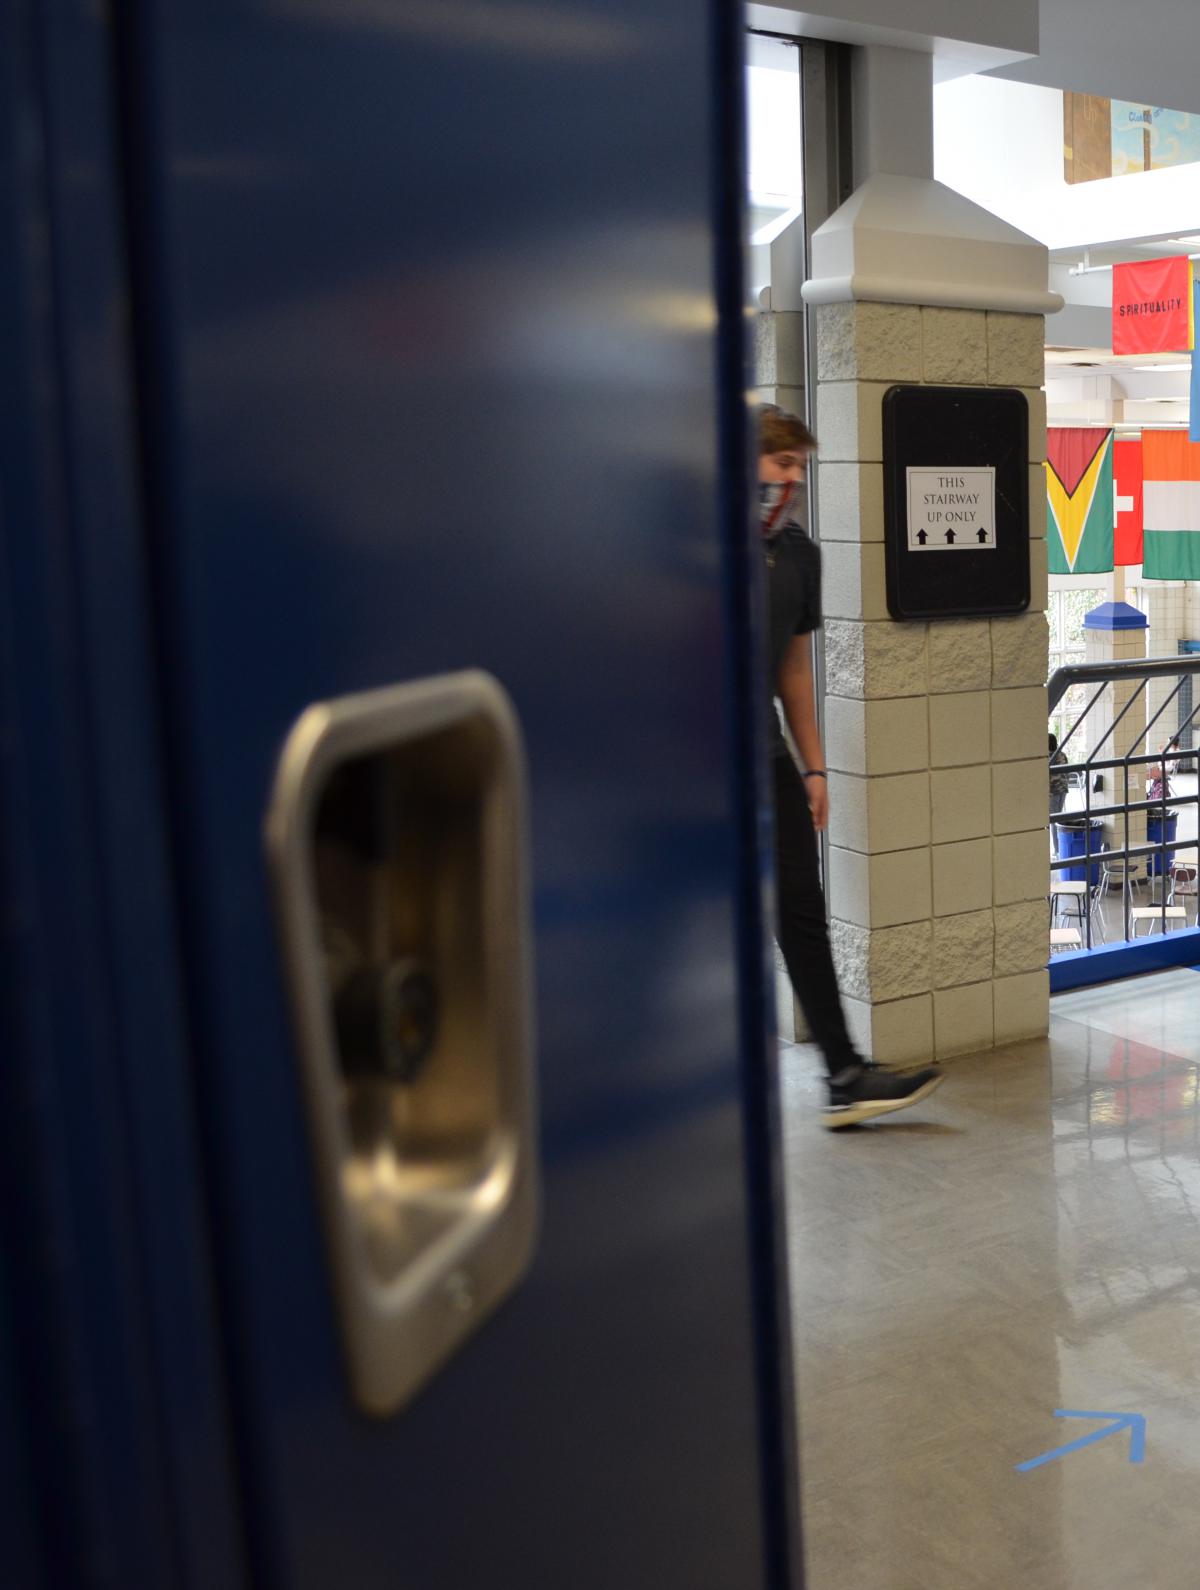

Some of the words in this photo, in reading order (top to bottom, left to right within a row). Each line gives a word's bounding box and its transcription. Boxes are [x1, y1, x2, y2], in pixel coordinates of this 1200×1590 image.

[1119, 298, 1181, 317] SPIRITUALITY
[937, 476, 966, 488] THIS
[923, 493, 980, 505] STAIRWAY
[927, 511, 942, 523] UP
[945, 511, 976, 522] ONLY
